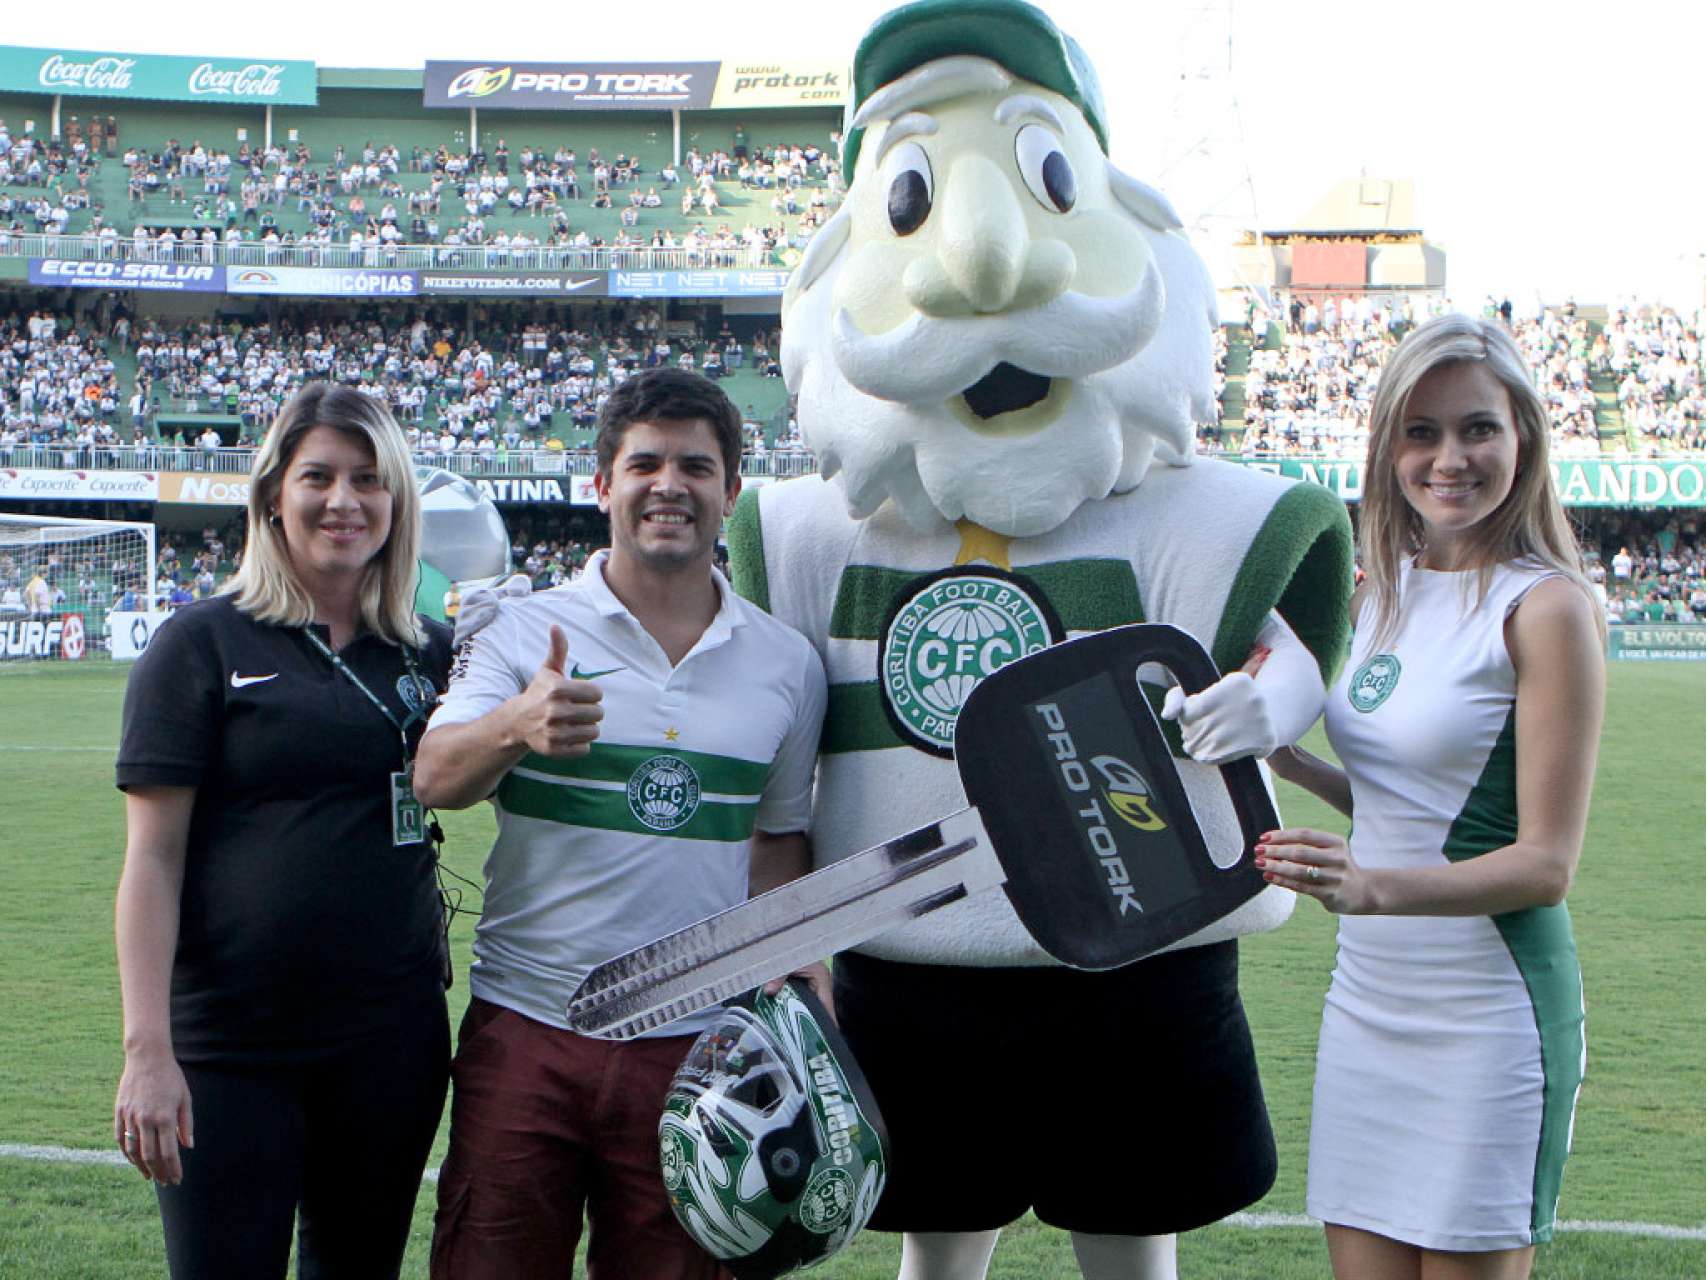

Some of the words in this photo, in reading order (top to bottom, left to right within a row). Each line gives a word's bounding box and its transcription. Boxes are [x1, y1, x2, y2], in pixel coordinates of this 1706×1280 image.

[40, 55, 136, 88] Coca-Cola
[189, 63, 285, 96] Coca-Cola
[735, 66, 781, 74] www
[511, 73, 589, 92] PRO
[594, 73, 693, 92] TORK
[734, 72, 840, 93] protork
[800, 90, 840, 99] com
[423, 276, 561, 289] NIKEFUTEBOL.COM
[617, 272, 667, 287] NET
[677, 272, 728, 287] NET
[889, 603, 928, 706] CORITIBA
[917, 638, 1013, 679] CFC
[644, 783, 683, 803] CFC
[1035, 702, 1091, 793] PRO
[1080, 798, 1144, 917] TORK
